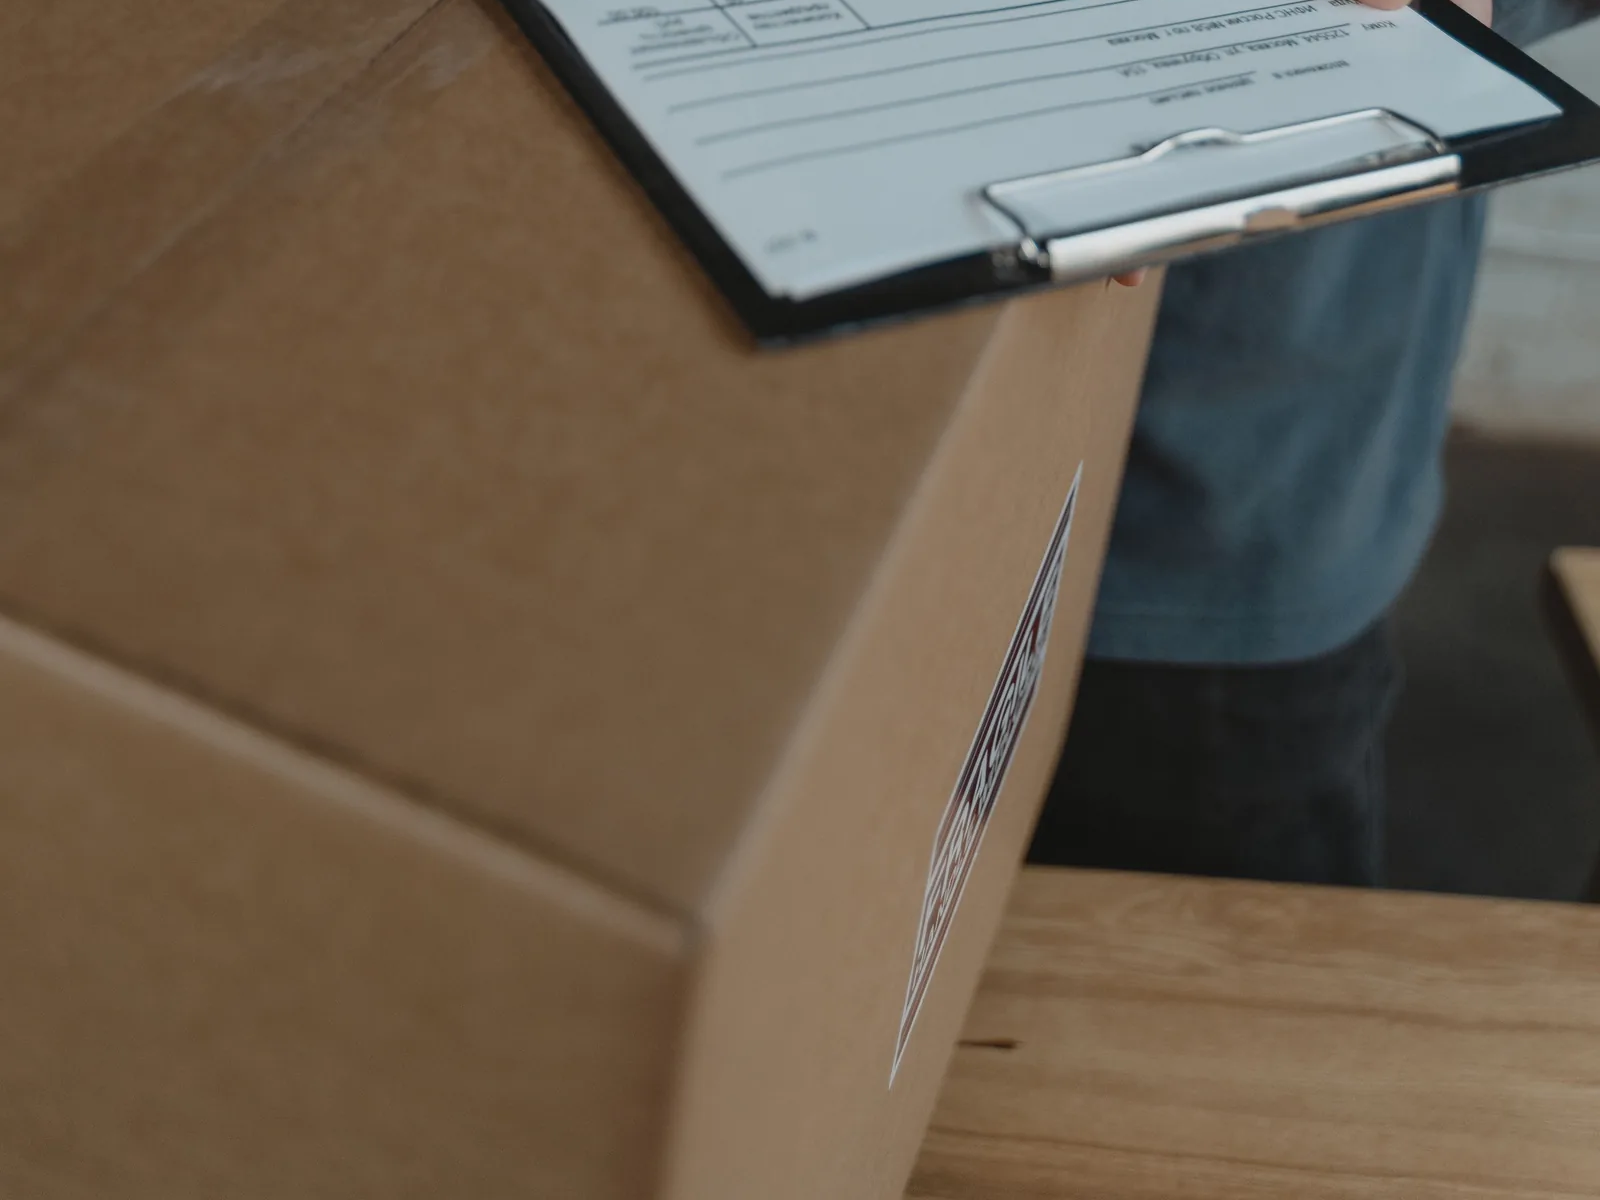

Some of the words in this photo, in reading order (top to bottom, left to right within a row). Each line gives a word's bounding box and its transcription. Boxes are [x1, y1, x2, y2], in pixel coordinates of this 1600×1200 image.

[1273, 4, 1318, 18] ИФНС
[1224, 12, 1276, 26] России
[1361, 20, 1397, 31] Кому
[914, 551, 1062, 970] FRAGILE
